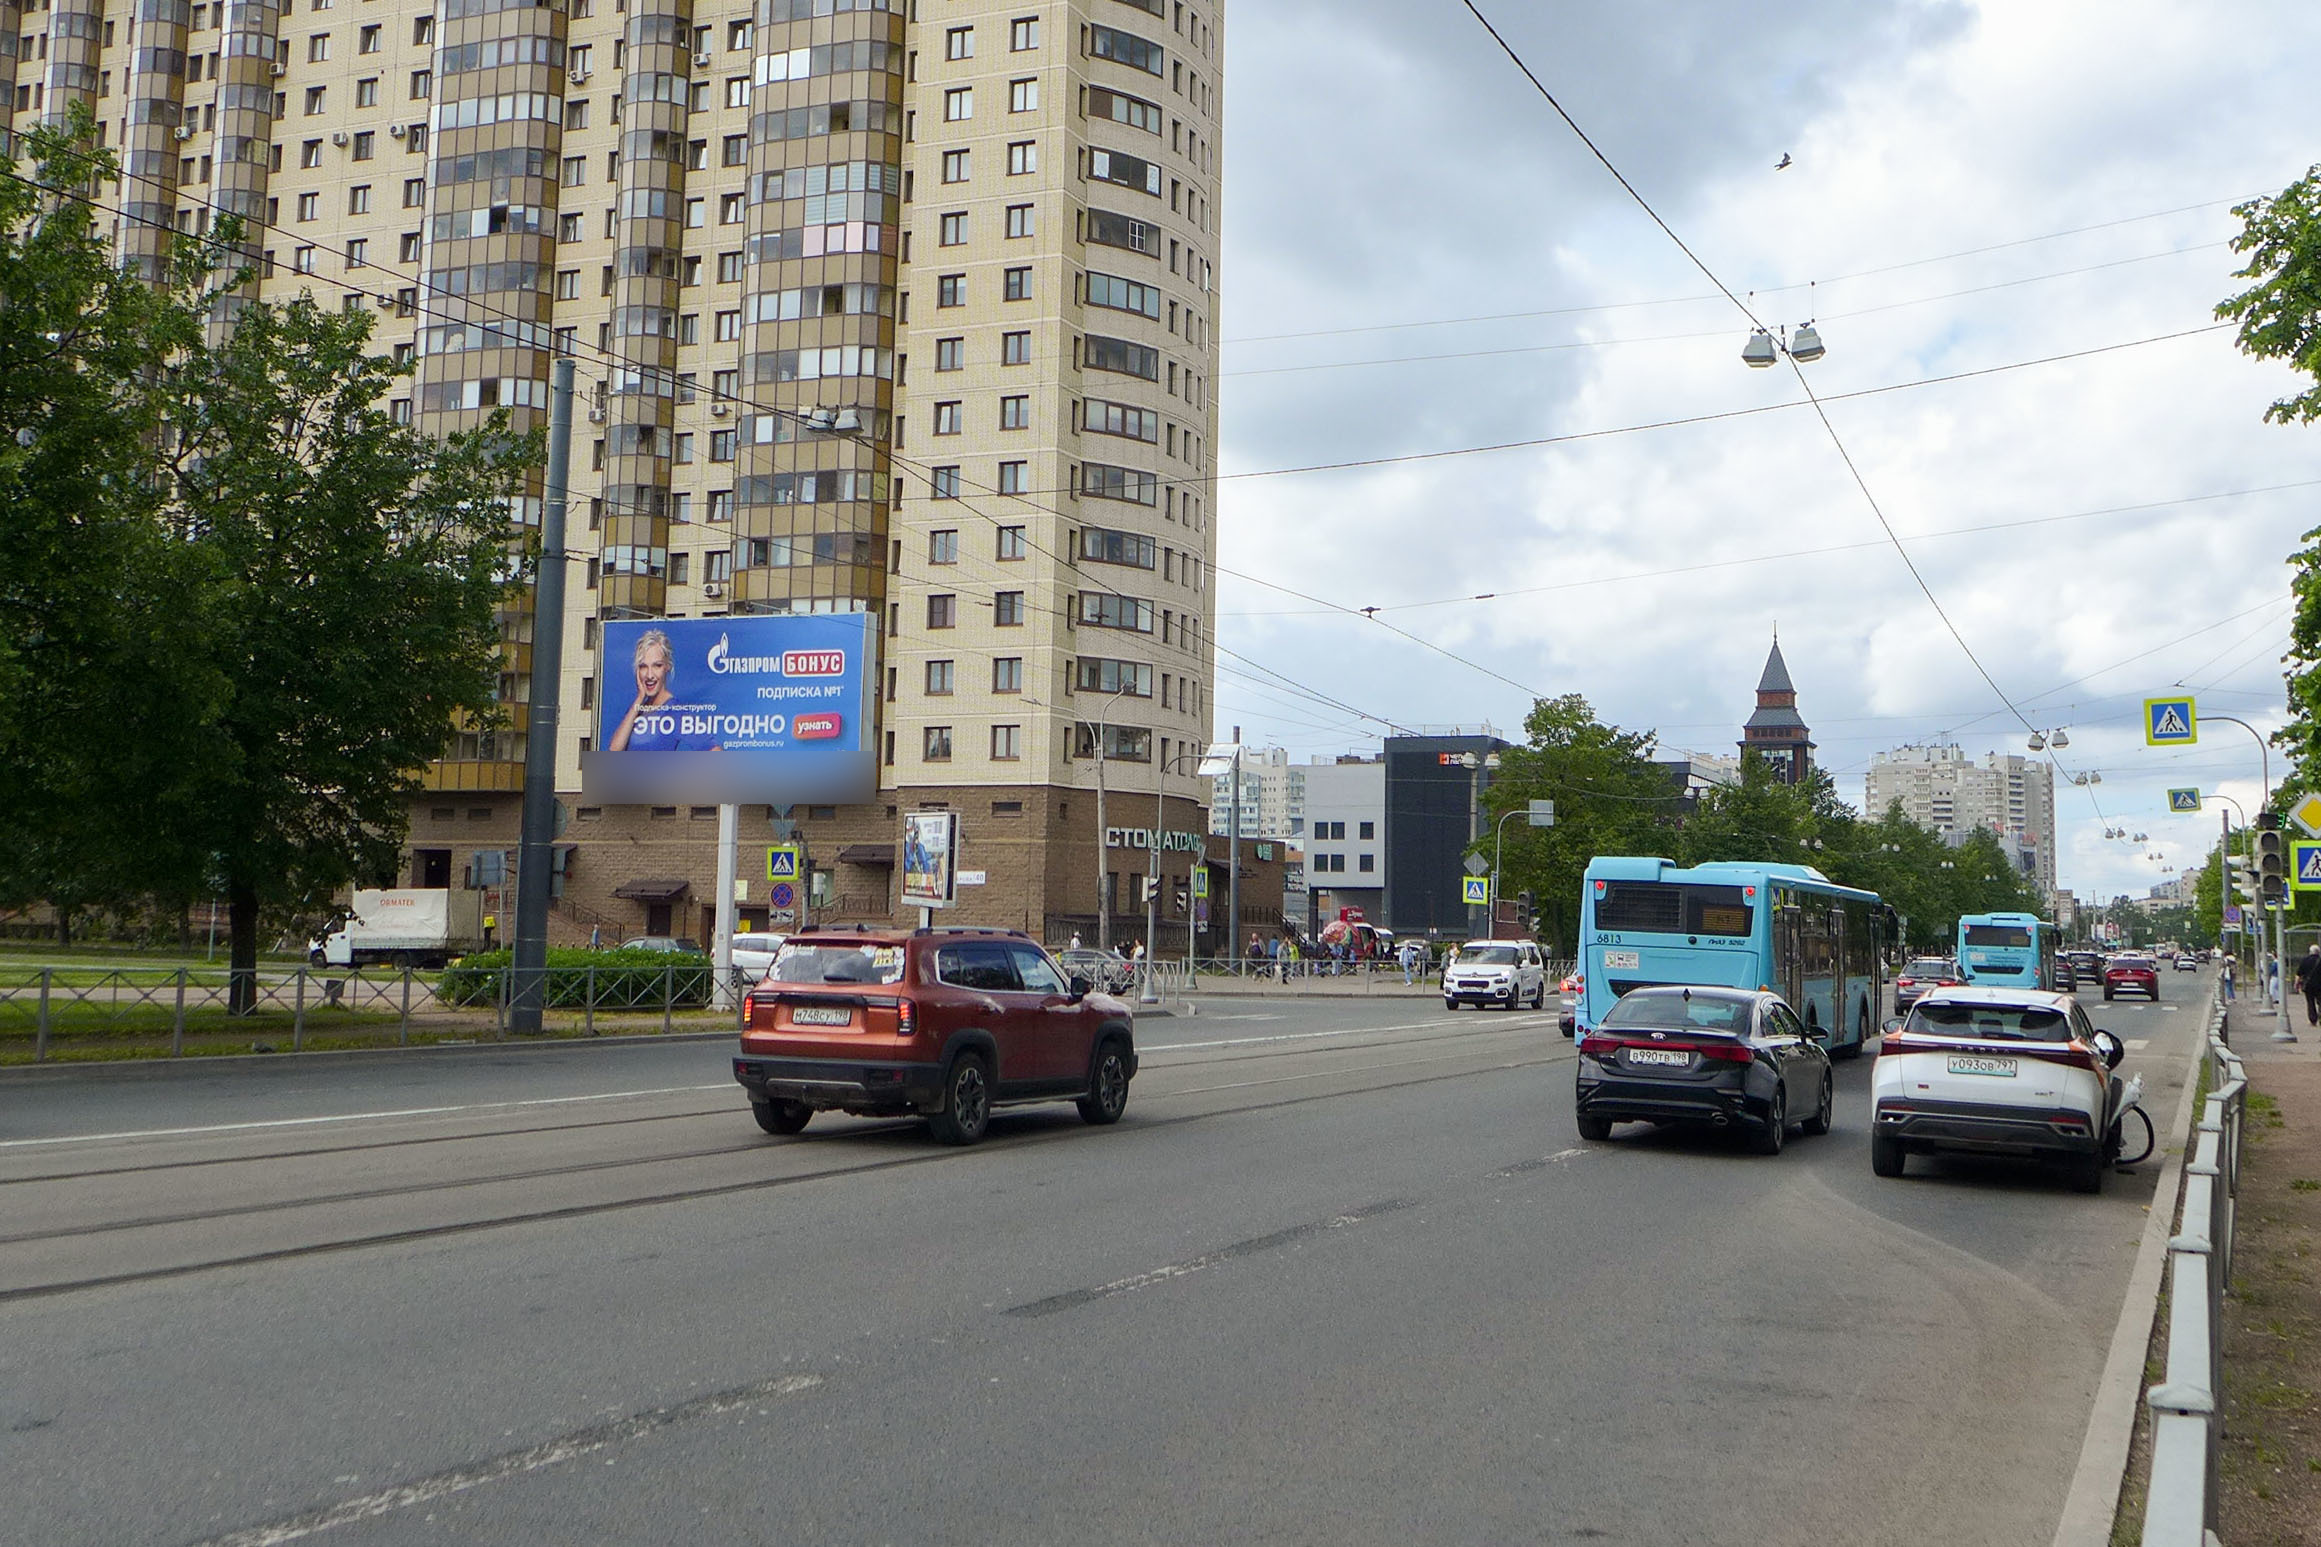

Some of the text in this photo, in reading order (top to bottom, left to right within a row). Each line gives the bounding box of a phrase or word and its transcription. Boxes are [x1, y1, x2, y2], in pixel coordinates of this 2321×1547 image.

[729, 655, 840, 673] ГАЗПРОМ БОНУС
[757, 686, 821, 700] ПОДПИСКА
[633, 714, 786, 738] ЭТО ВЫГОДНО
[798, 720, 833, 735] узнать
[723, 740, 785, 750] gazprombonus.ru
[1597, 934, 1622, 944] 6813
[1632, 1050, 1687, 1062] В990ТВ 198
[1952, 1058, 2013, 1071] У093ОВ 797
